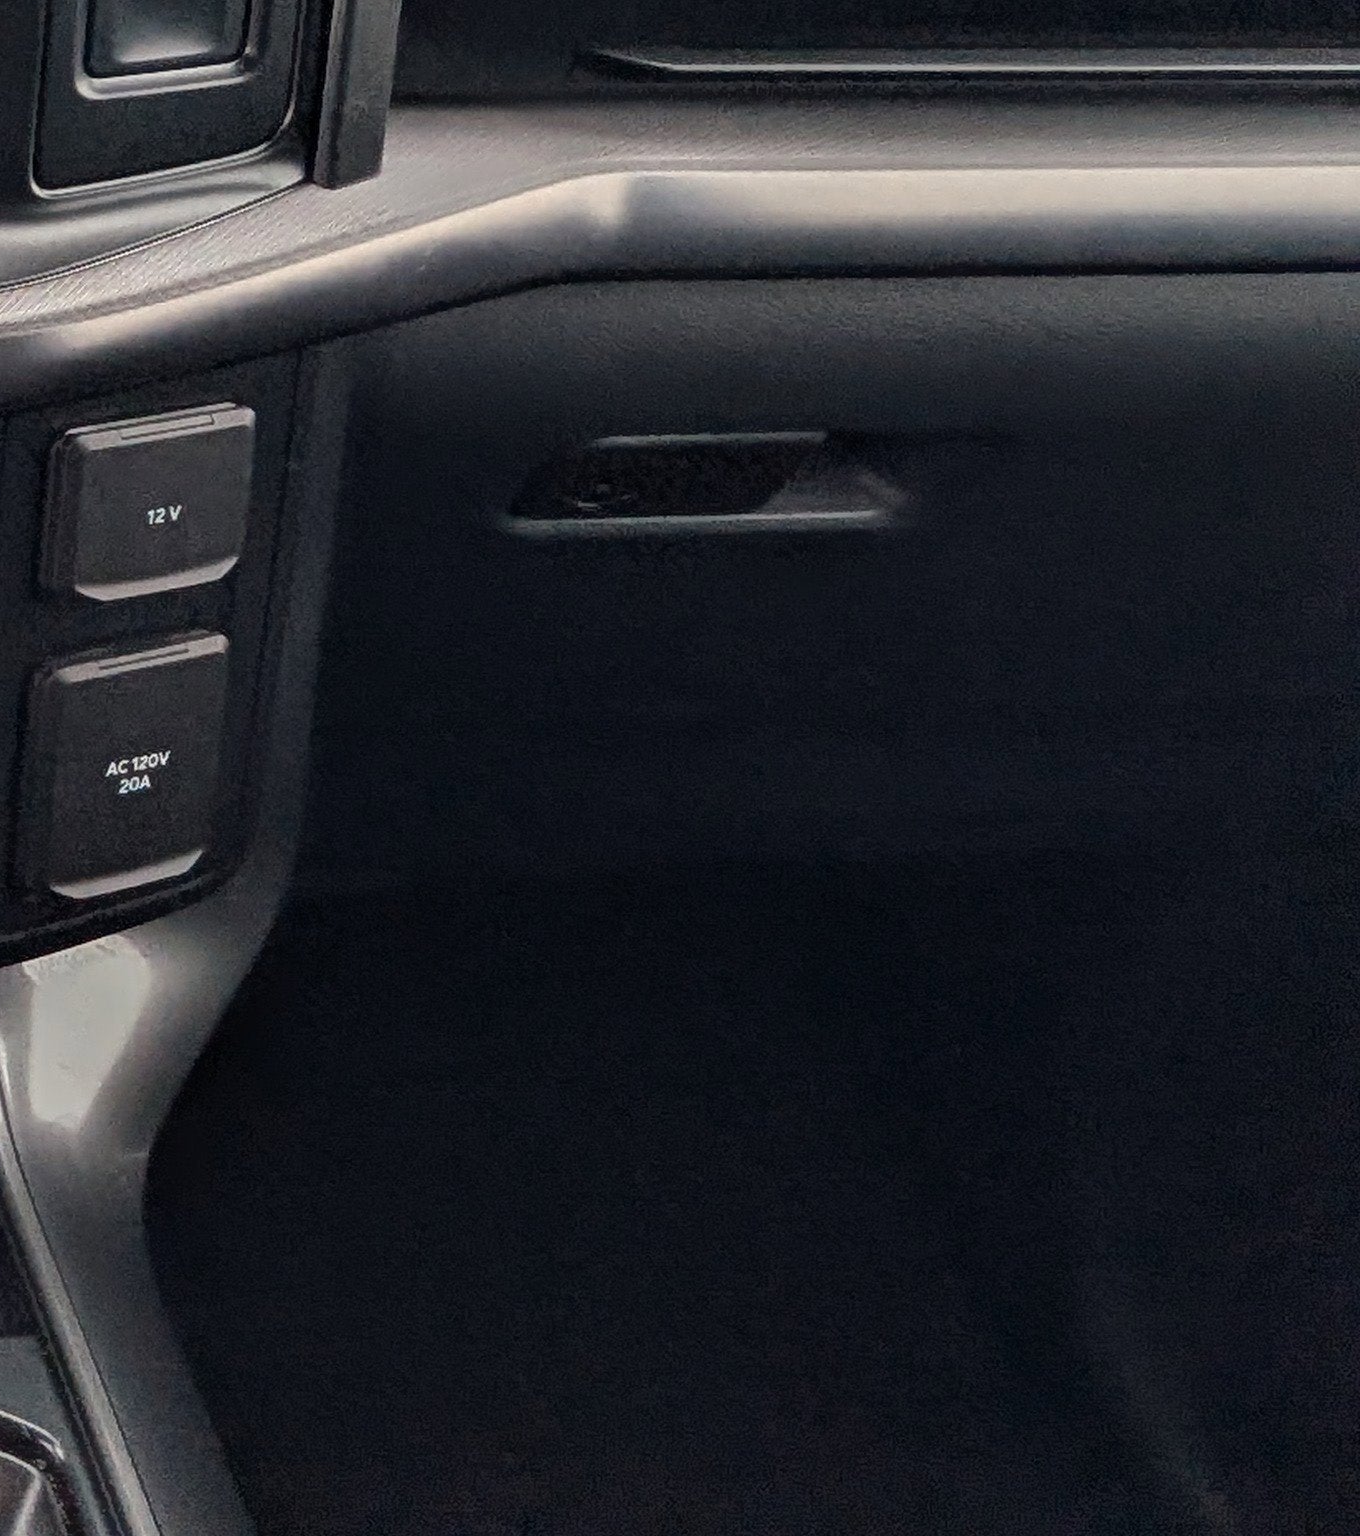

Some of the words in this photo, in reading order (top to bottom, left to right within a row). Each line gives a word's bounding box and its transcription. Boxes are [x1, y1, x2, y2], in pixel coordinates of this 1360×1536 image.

[147, 507, 166, 525] 12
[169, 505, 183, 522] V
[105, 758, 130, 778] AC
[131, 750, 171, 773] 120V
[117, 774, 152, 794] 20A
